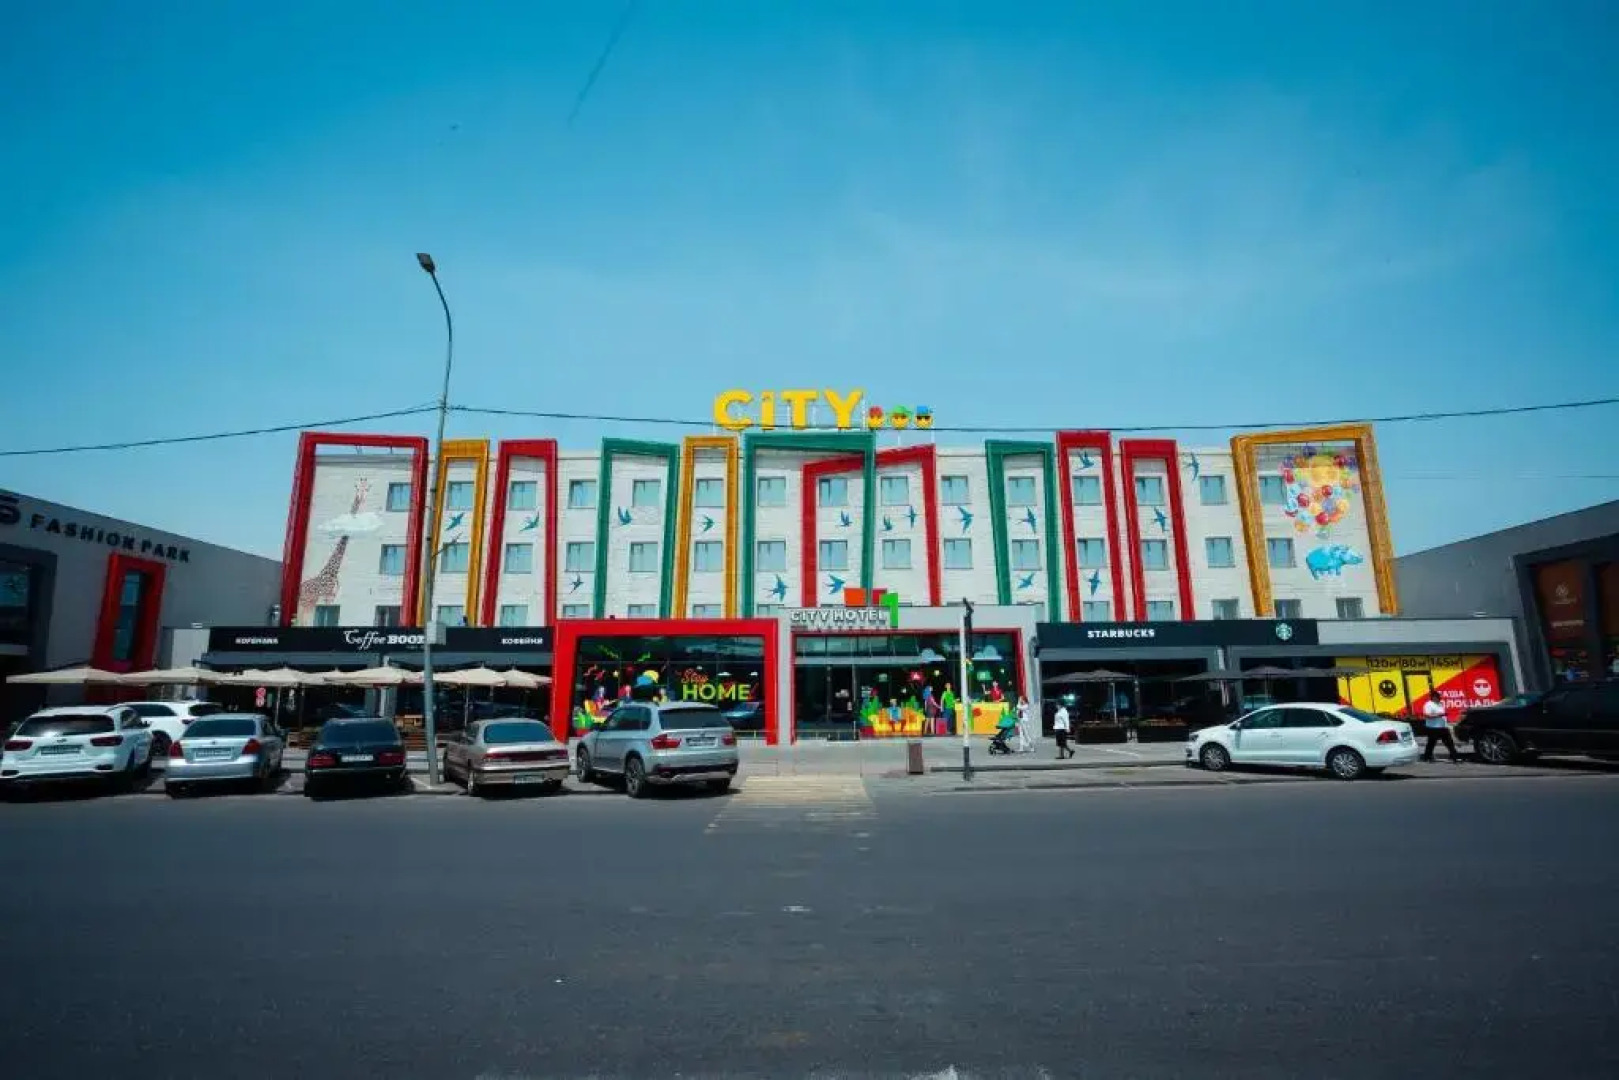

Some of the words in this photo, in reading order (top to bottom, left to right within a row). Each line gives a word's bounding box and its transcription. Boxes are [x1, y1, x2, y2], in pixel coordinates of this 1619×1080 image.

[30, 513, 135, 550] FASHION
[141, 540, 190, 563] PARK
[791, 609, 831, 621] CITY
[833, 608, 886, 621] HOTEL
[343, 629, 386, 650] Coffee
[1087, 629, 1155, 638] STARBUCKS
[682, 683, 751, 700] HOME
